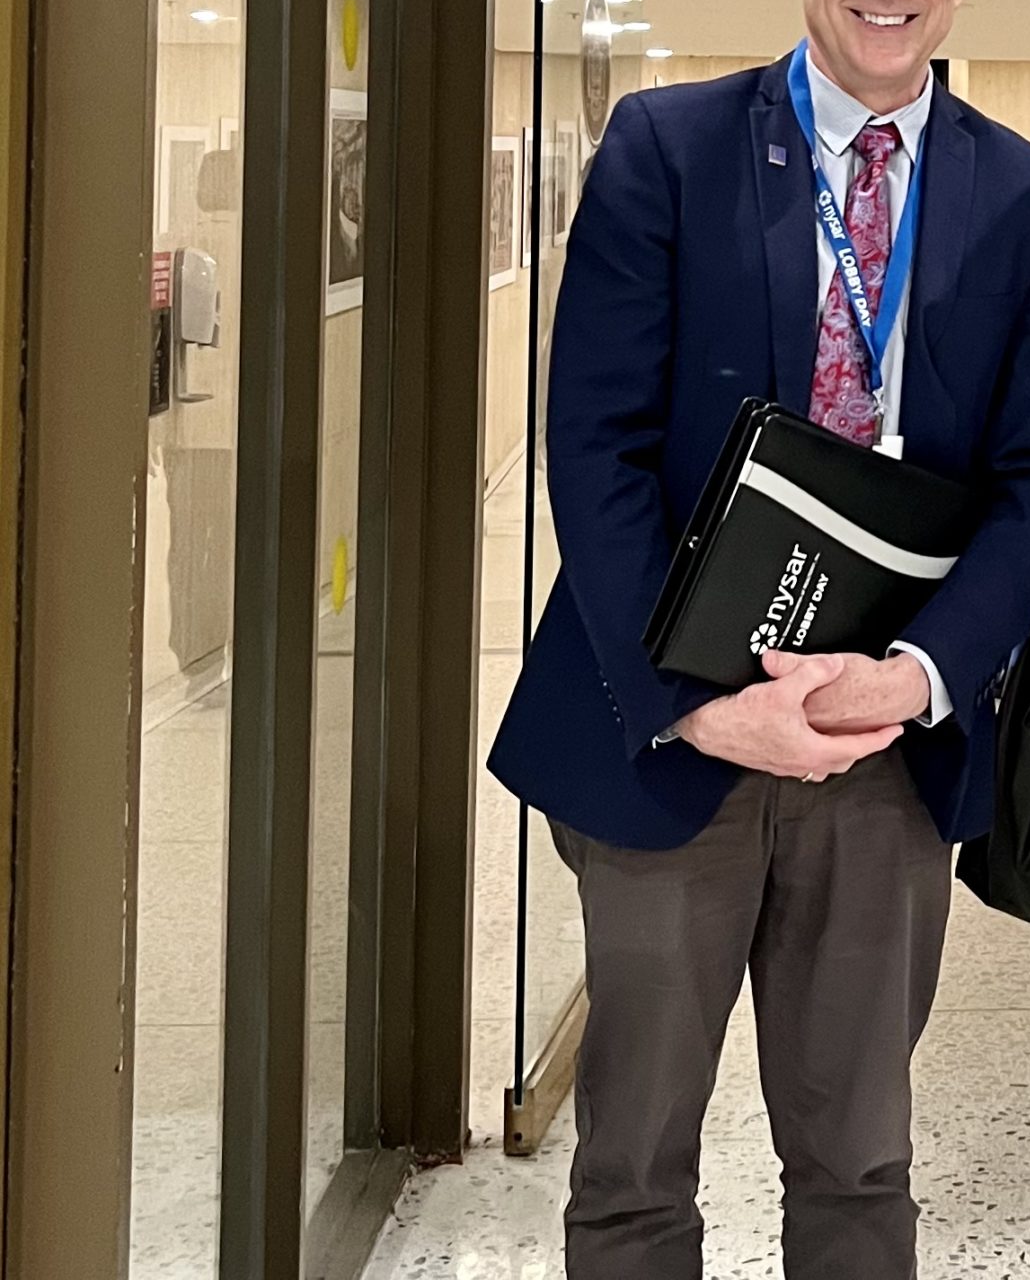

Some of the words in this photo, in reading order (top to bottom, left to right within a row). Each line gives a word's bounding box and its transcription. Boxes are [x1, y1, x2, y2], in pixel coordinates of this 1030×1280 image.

[823, 207, 846, 240] nysar
[838, 247, 864, 295] LOBBY
[855, 297, 872, 328] DAY
[766, 543, 808, 621] nysar
[792, 602, 817, 646] LOBBY
[811, 573, 829, 602] DAY
